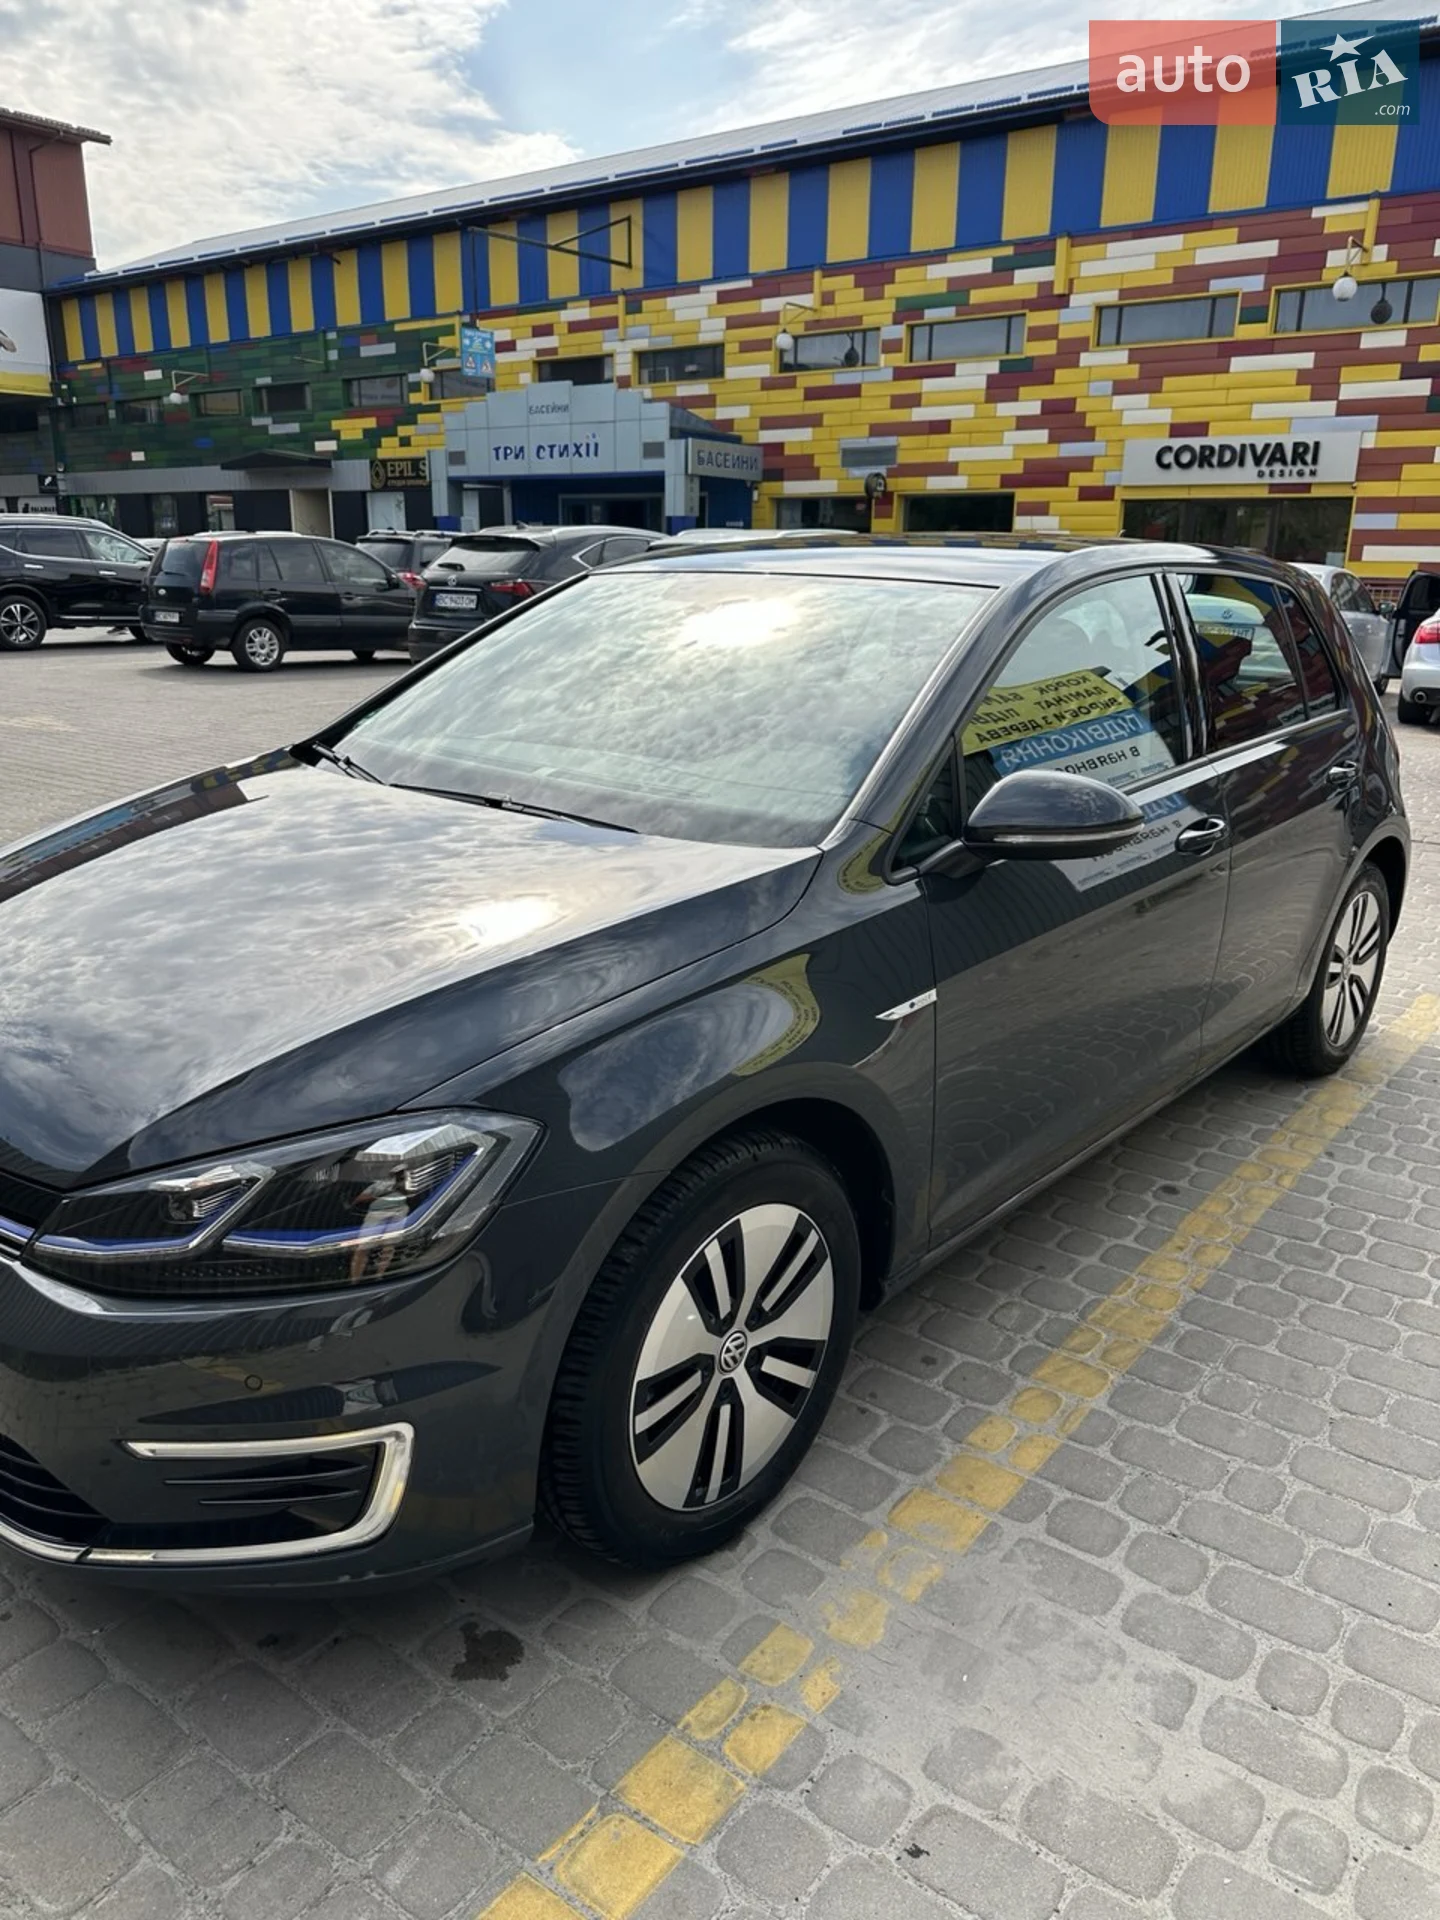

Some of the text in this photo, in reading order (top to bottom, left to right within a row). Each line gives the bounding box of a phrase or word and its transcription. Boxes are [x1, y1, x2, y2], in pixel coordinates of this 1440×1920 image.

[492, 445, 525, 460] ТРИ
[1155, 441, 1321, 470] CORDIVARI
[387, 461, 416, 477] EPIL
[1257, 469, 1318, 478] DESIGN
